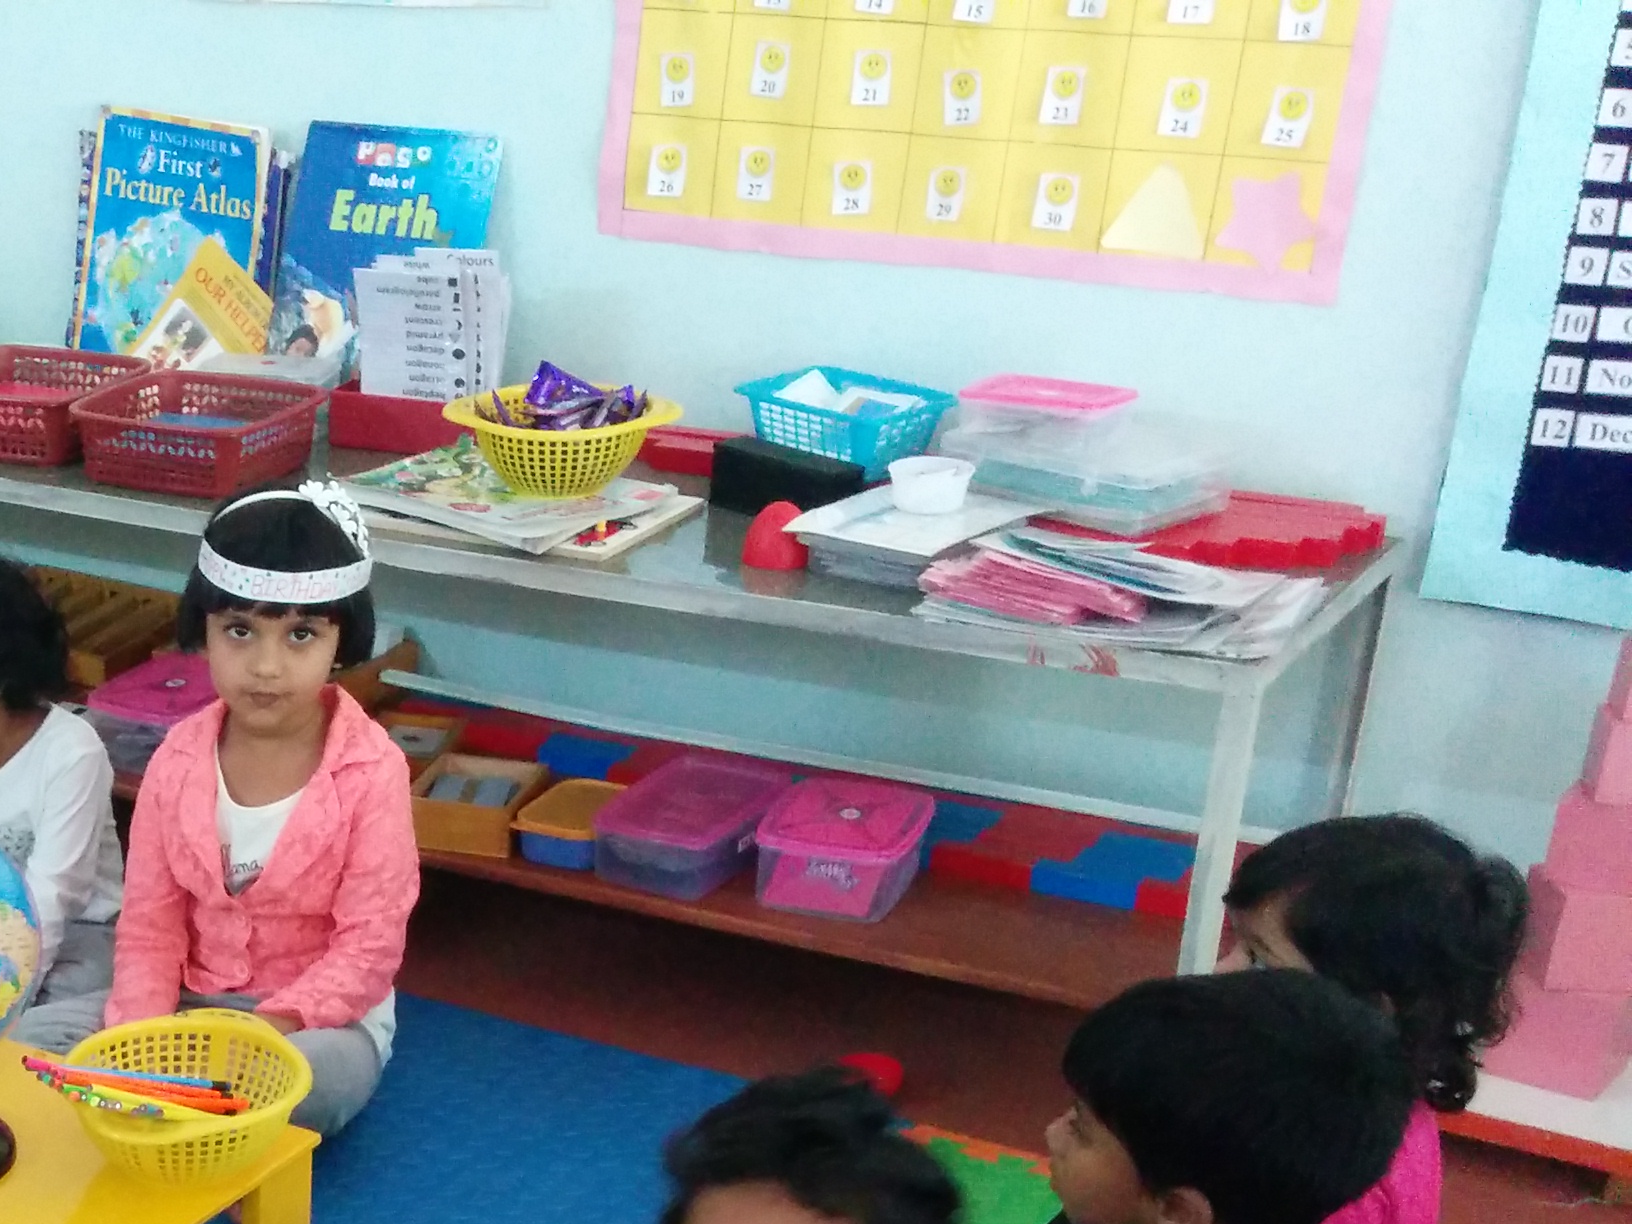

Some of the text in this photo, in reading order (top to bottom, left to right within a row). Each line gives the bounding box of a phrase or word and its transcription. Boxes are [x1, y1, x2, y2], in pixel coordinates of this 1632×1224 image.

[968, 5, 983, 18] 15
[1182, 5, 1199, 19] 17
[1294, 22, 1311, 36] 18
[760, 80, 776, 94] 20
[671, 89, 685, 103] 19
[862, 88, 877, 102] 21
[955, 107, 970, 122] 22
[1052, 107, 1068, 121] 23
[1612, 102, 1626, 118] 6
[1171, 119, 1188, 134] 24
[118, 123, 227, 153] THE KINGFISHER
[1275, 128, 1294, 142] 25
[157, 149, 203, 178] First
[1602, 153, 1616, 174] 7
[369, 173, 416, 190] Book of
[659, 180, 673, 193] 26
[103, 167, 252, 220] Picture Atlas
[747, 183, 762, 197] 27
[843, 198, 859, 211] 28
[936, 203, 952, 217] 29
[329, 188, 438, 240] Earth
[1044, 212, 1062, 226] 30
[1589, 206, 1604, 228] 8
[1580, 256, 1595, 277] 9
[195, 267, 226, 306] OUR
[1562, 313, 1588, 334] 10
[1551, 365, 1575, 386] 11
[1540, 418, 1567, 440] 12
